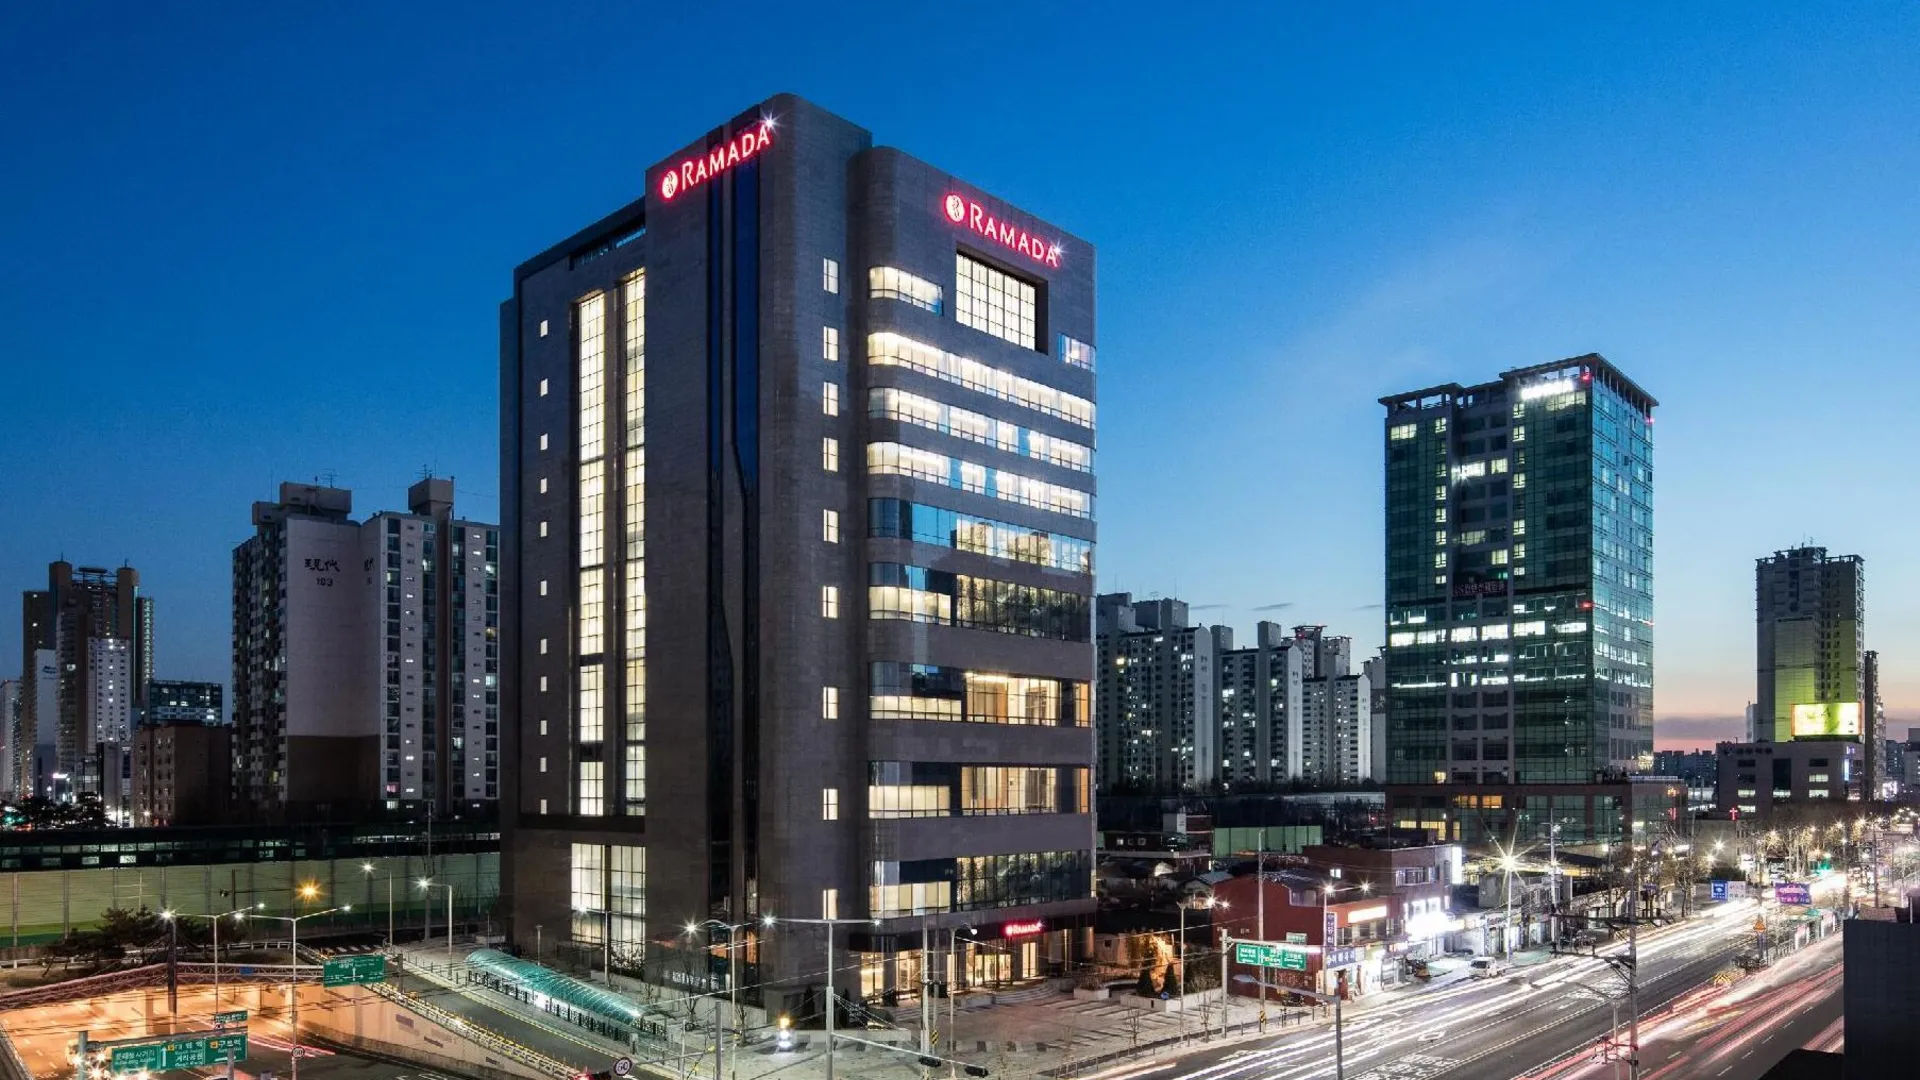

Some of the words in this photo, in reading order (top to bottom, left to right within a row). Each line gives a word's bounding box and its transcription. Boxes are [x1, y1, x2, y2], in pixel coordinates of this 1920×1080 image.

[681, 123, 771, 191] RAMADA
[969, 202, 1059, 268] RAMADA
[316, 577, 334, 587] 103
